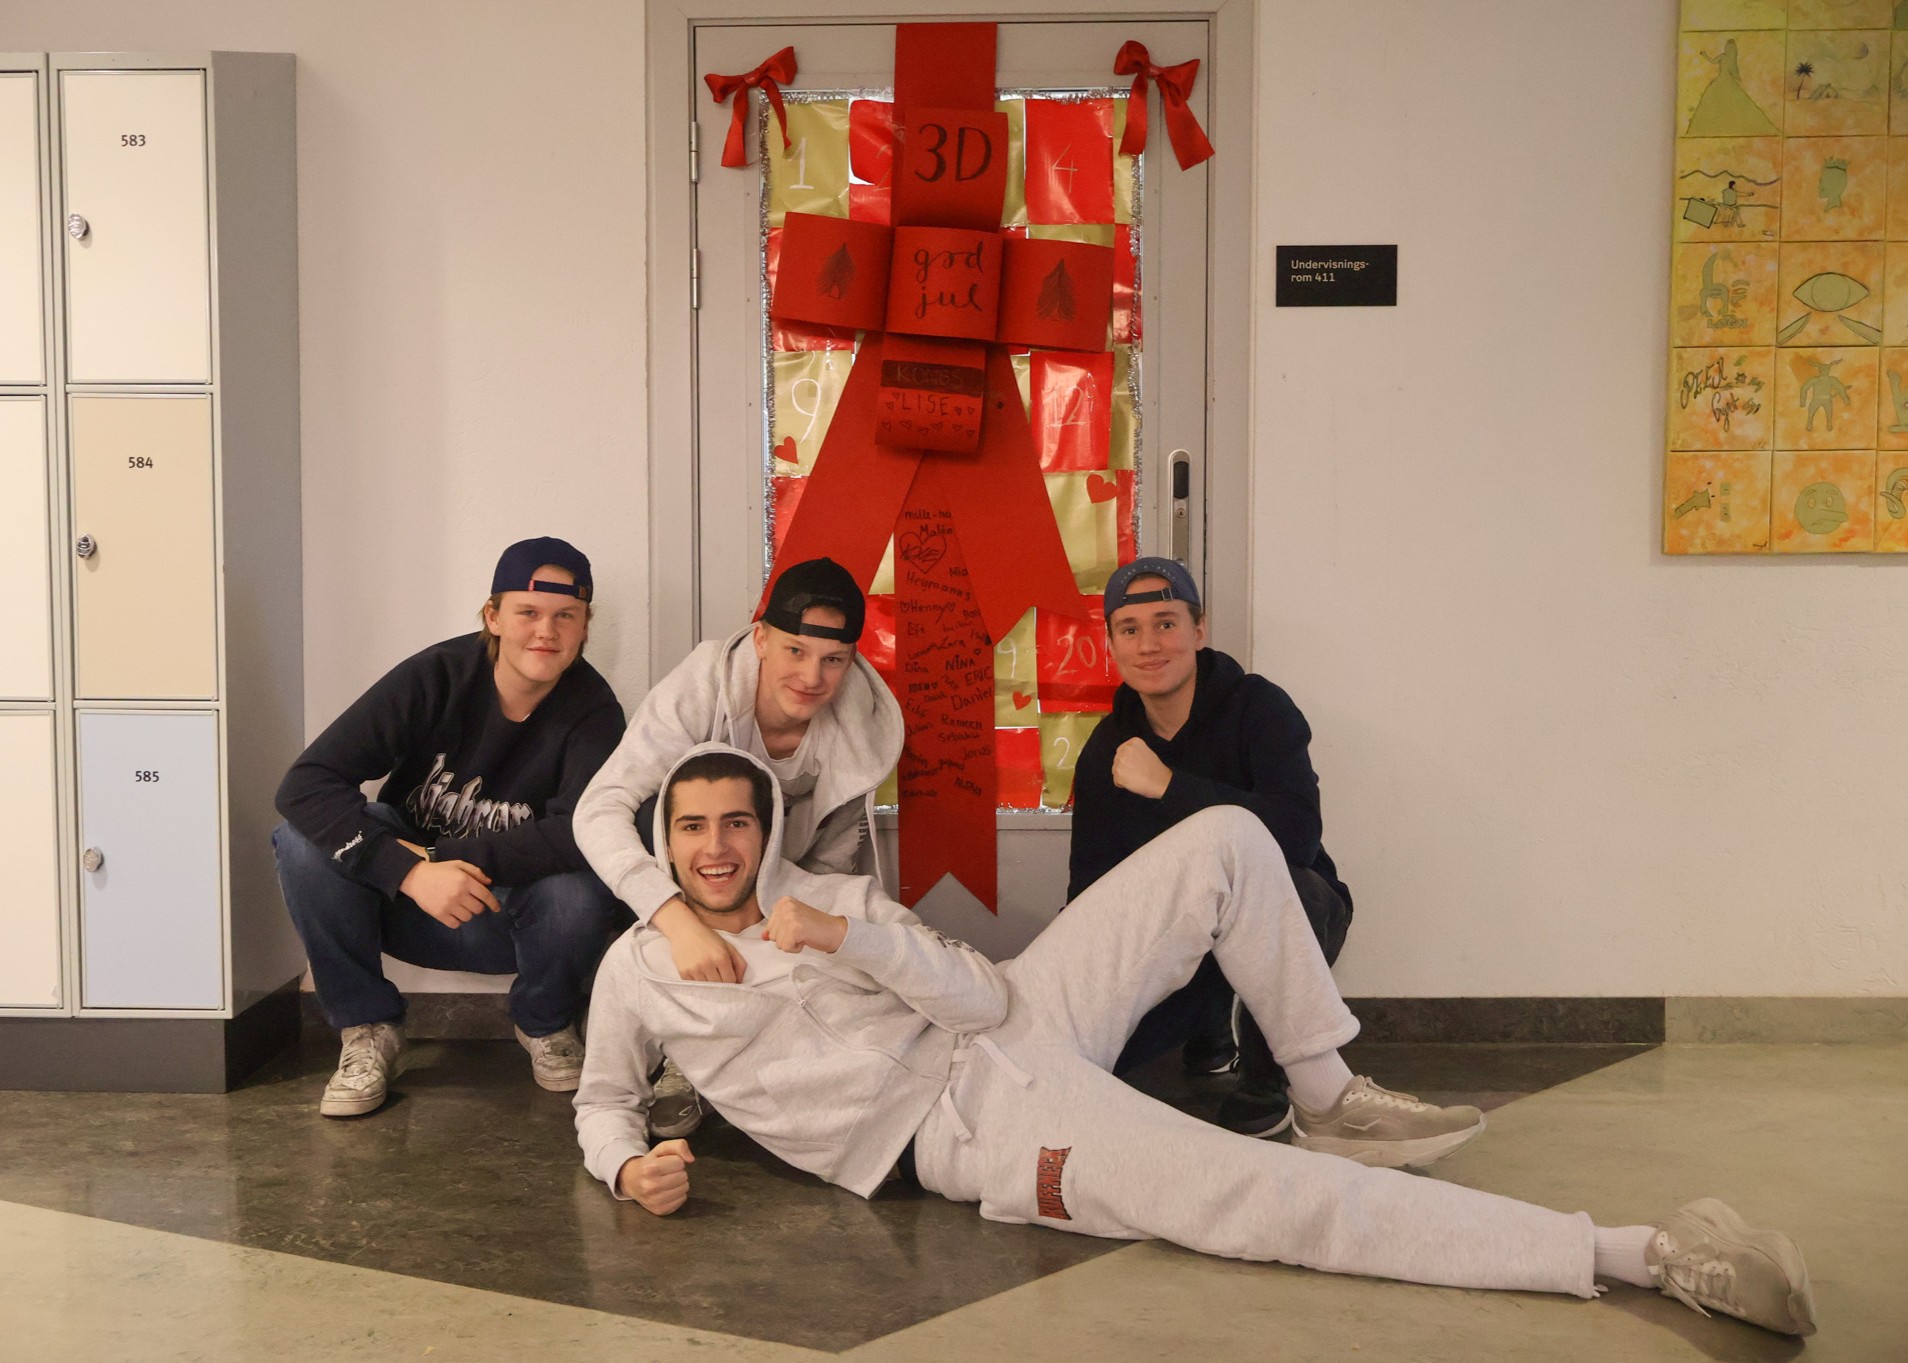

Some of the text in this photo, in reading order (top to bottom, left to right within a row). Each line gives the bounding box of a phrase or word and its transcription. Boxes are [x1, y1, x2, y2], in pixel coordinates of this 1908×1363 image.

[121, 134, 146, 147] 583
[915, 122, 993, 183] 3D
[787, 137, 815, 190] 1
[914, 240, 984, 283] god
[1290, 259, 1369, 271] Undervisnings-
[1290, 272, 1335, 282] rom 411
[915, 284, 983, 319] jul
[791, 378, 822, 445] 9
[902, 392, 950, 416] LISE
[128, 456, 154, 469] 584
[1057, 634, 1098, 675] 20
[135, 770, 160, 783] 585
